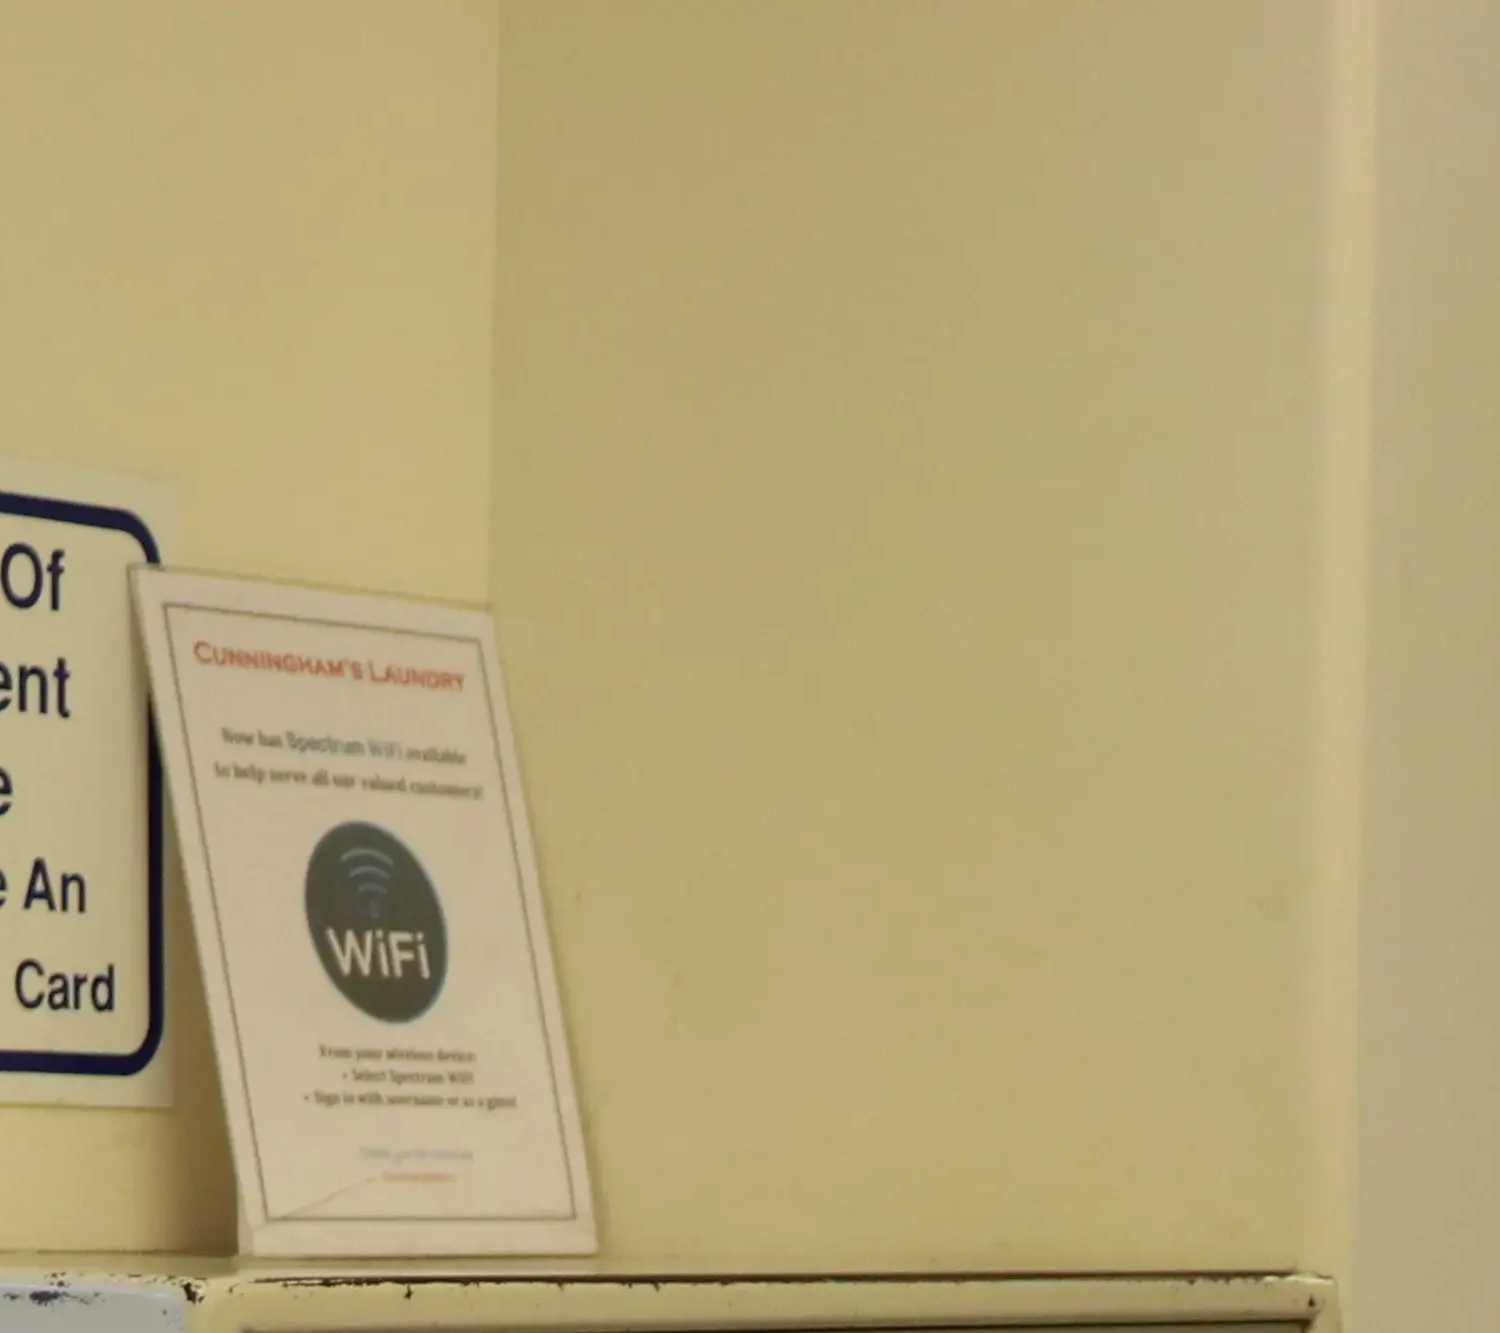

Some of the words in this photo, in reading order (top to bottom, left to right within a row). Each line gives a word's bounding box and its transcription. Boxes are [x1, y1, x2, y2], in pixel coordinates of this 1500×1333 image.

[0, 542, 66, 611] Of
[368, 659, 466, 694] LAUNDRY
[285, 730, 365, 756] Spectrum
[22, 857, 88, 914] An
[325, 925, 431, 981] WiFi
[15, 957, 116, 1013] Card
